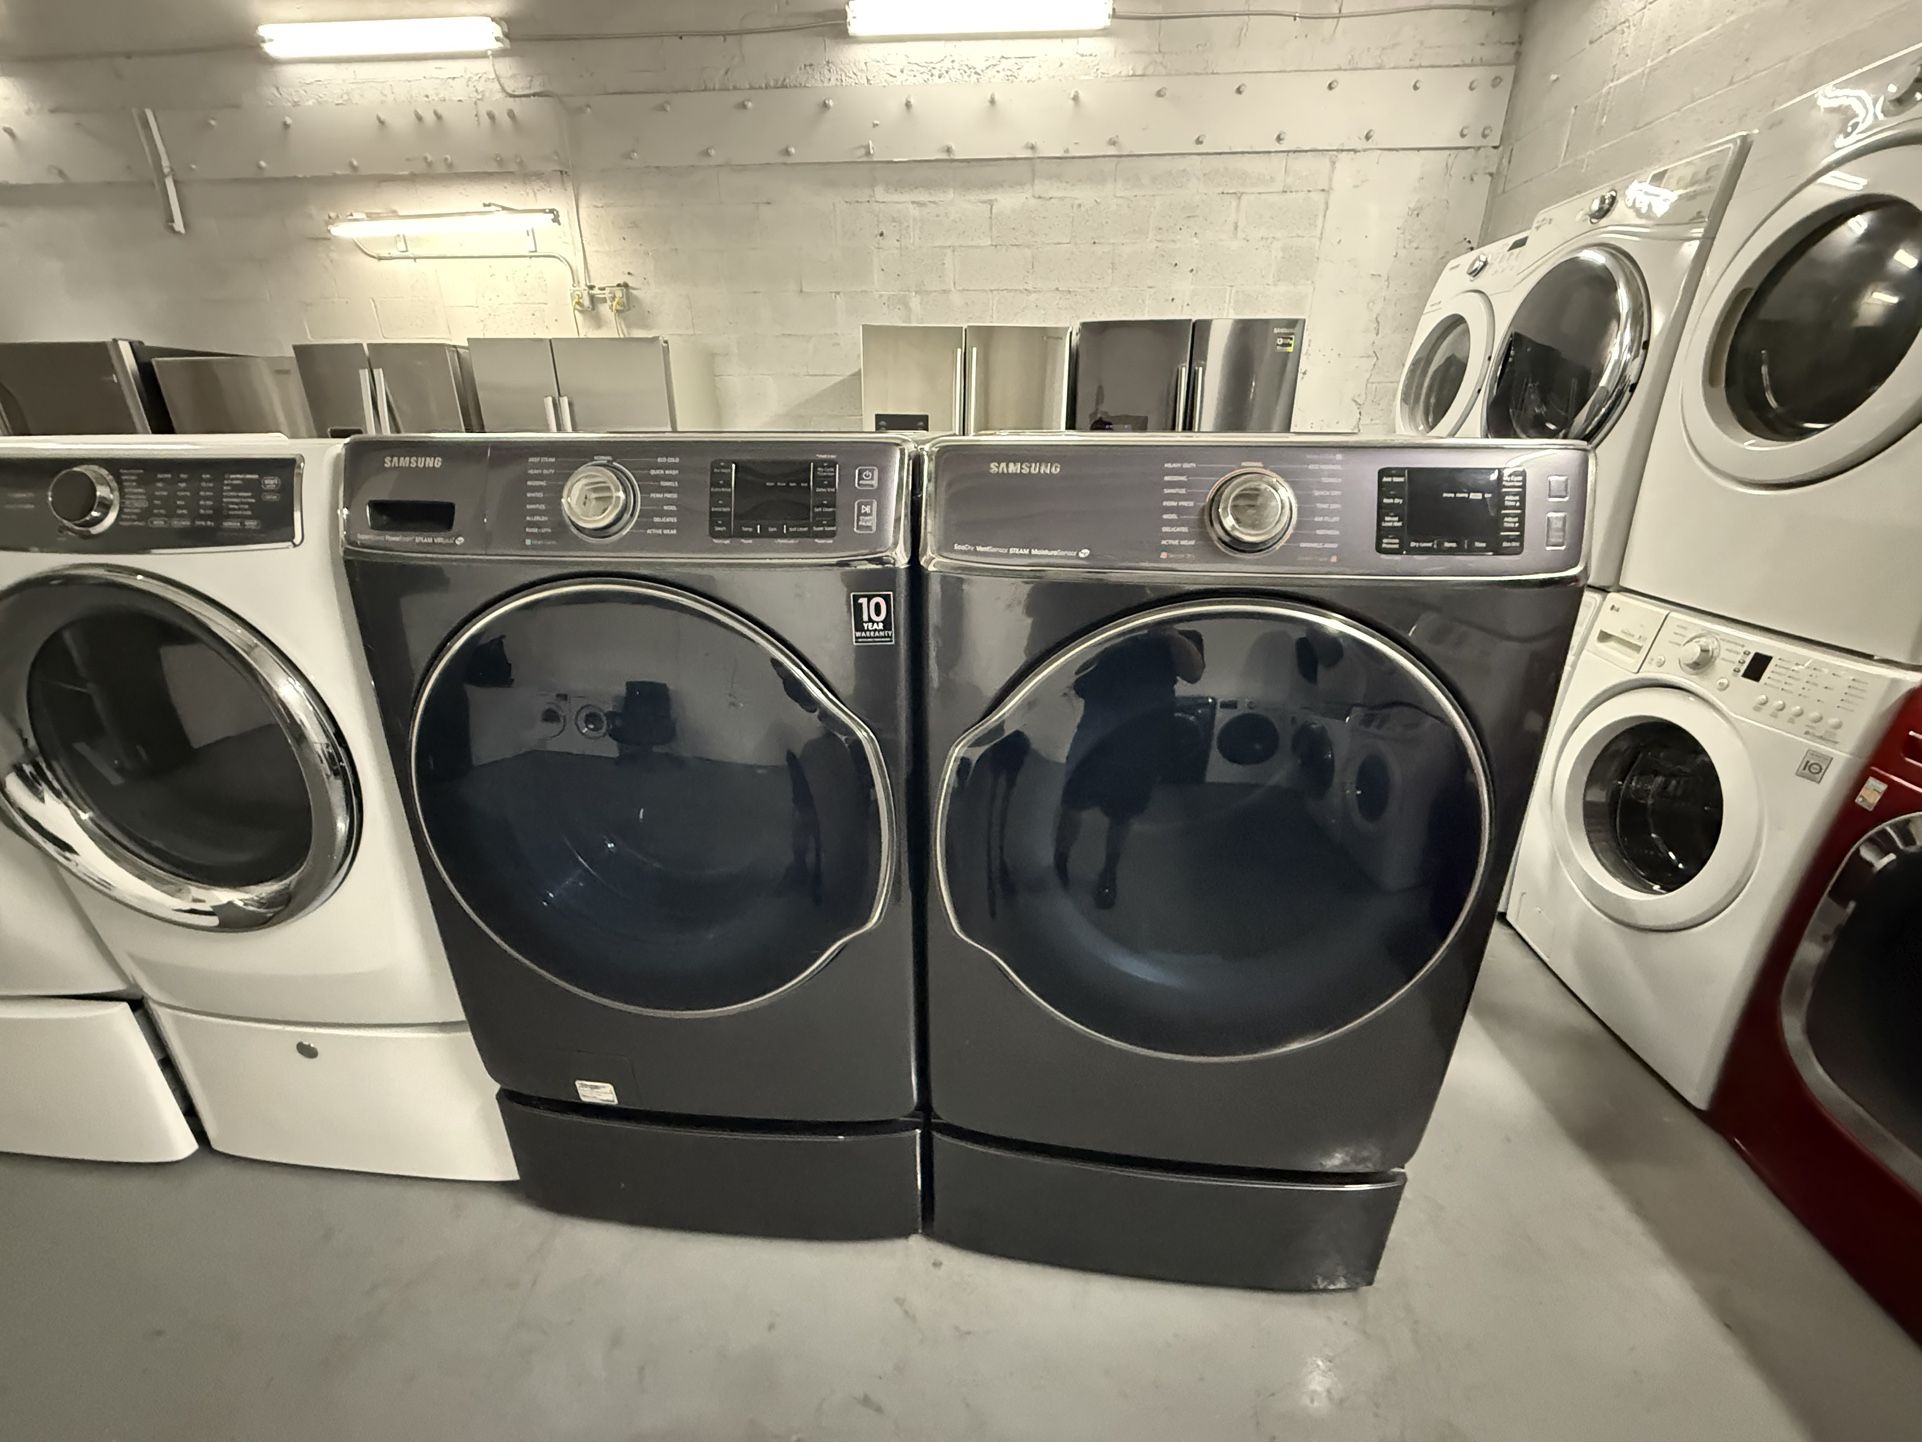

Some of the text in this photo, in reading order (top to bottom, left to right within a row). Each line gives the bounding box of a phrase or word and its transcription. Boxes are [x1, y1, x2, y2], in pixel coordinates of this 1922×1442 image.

[384, 456, 442, 468] SAMSUNG
[989, 462, 1061, 474] SAMSUNG
[858, 596, 886, 622] 10
[863, 622, 884, 630] YEAR
